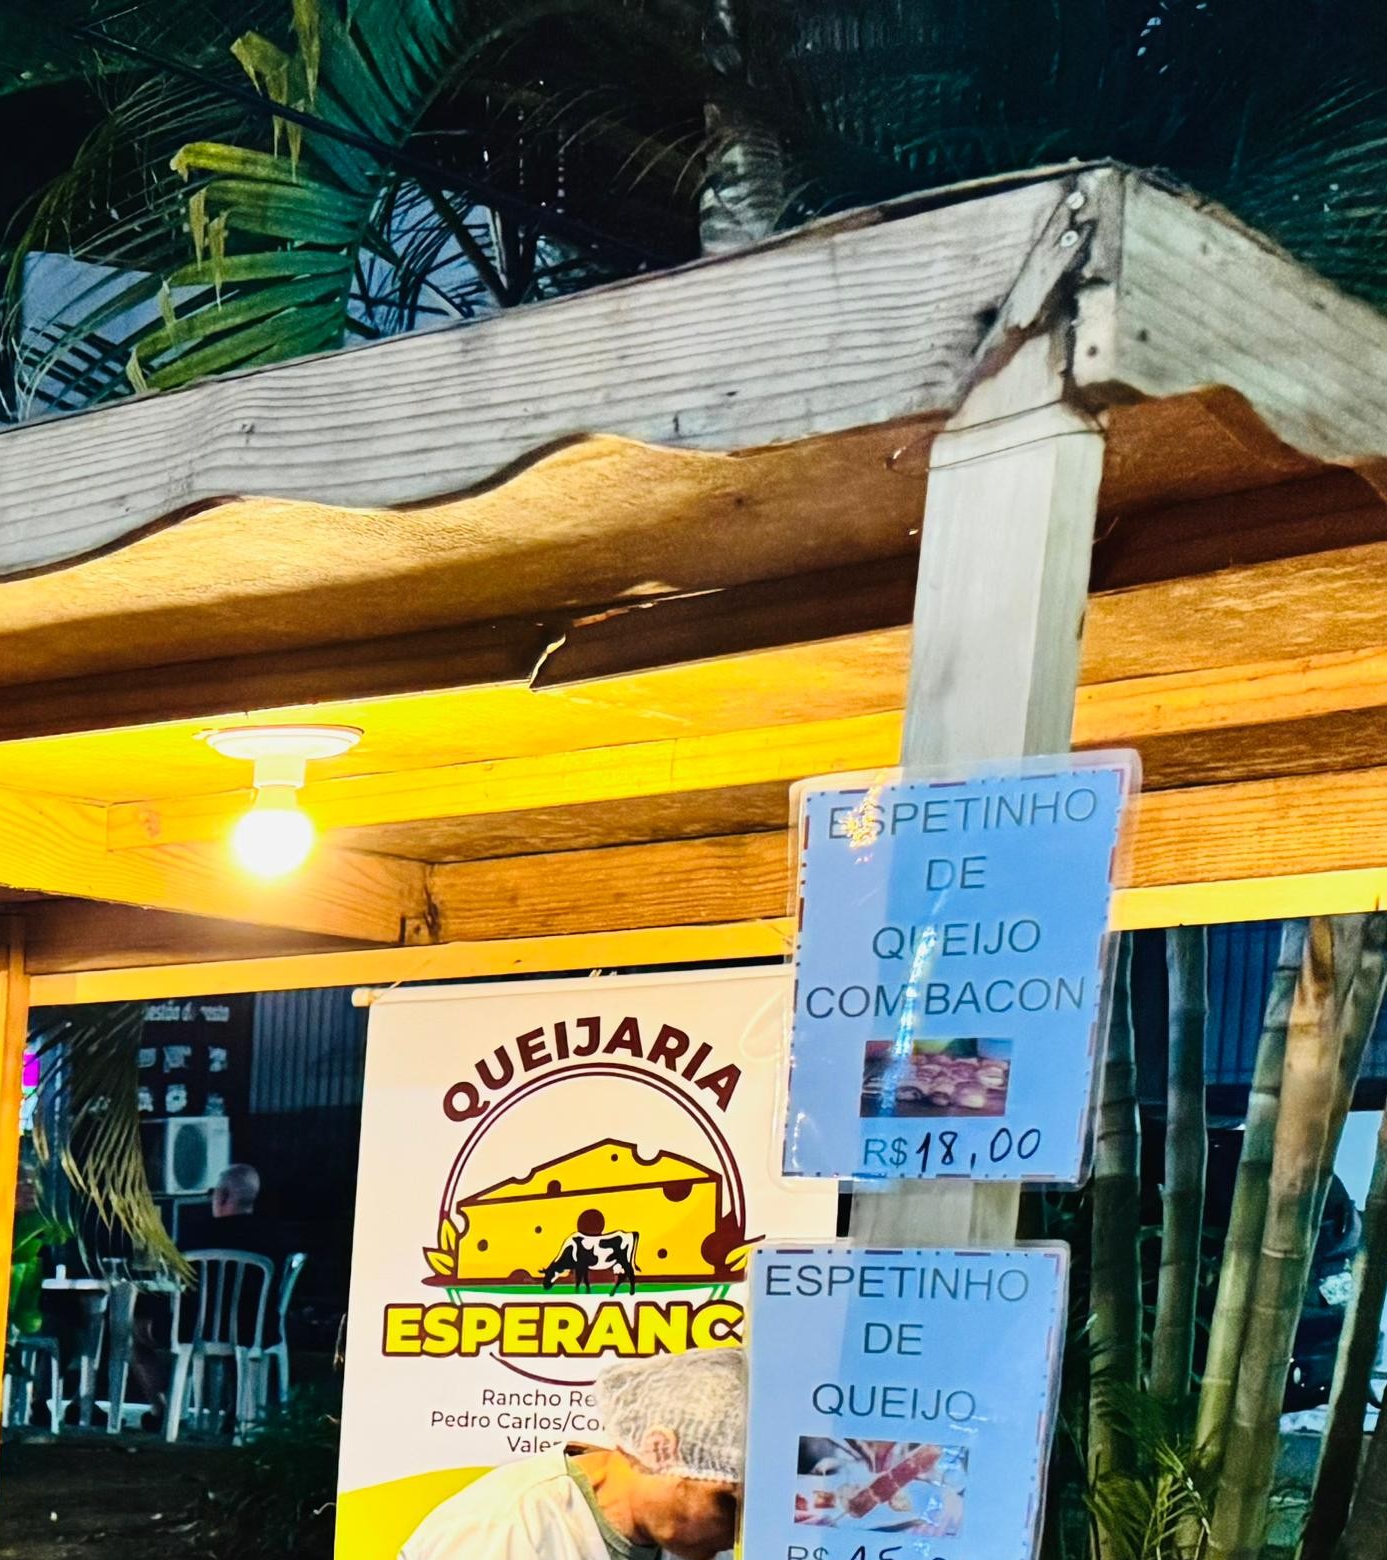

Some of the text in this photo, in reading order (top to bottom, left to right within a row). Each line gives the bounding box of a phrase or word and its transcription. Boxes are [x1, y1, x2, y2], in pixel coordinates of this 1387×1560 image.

[828, 788, 1099, 840] ESPETINHO
[927, 856, 988, 891] DE
[872, 919, 1041, 960] QUEIJO
[806, 976, 1085, 1019] COM BACON
[442, 1015, 743, 1123] QUEIJARIA
[765, 1265, 1029, 1302] ESPETINHO
[863, 1323, 924, 1355] DE
[481, 1389, 562, 1408] Rancho
[811, 1383, 977, 1422] QUEIJO
[430, 1411, 491, 1430] Pedro
